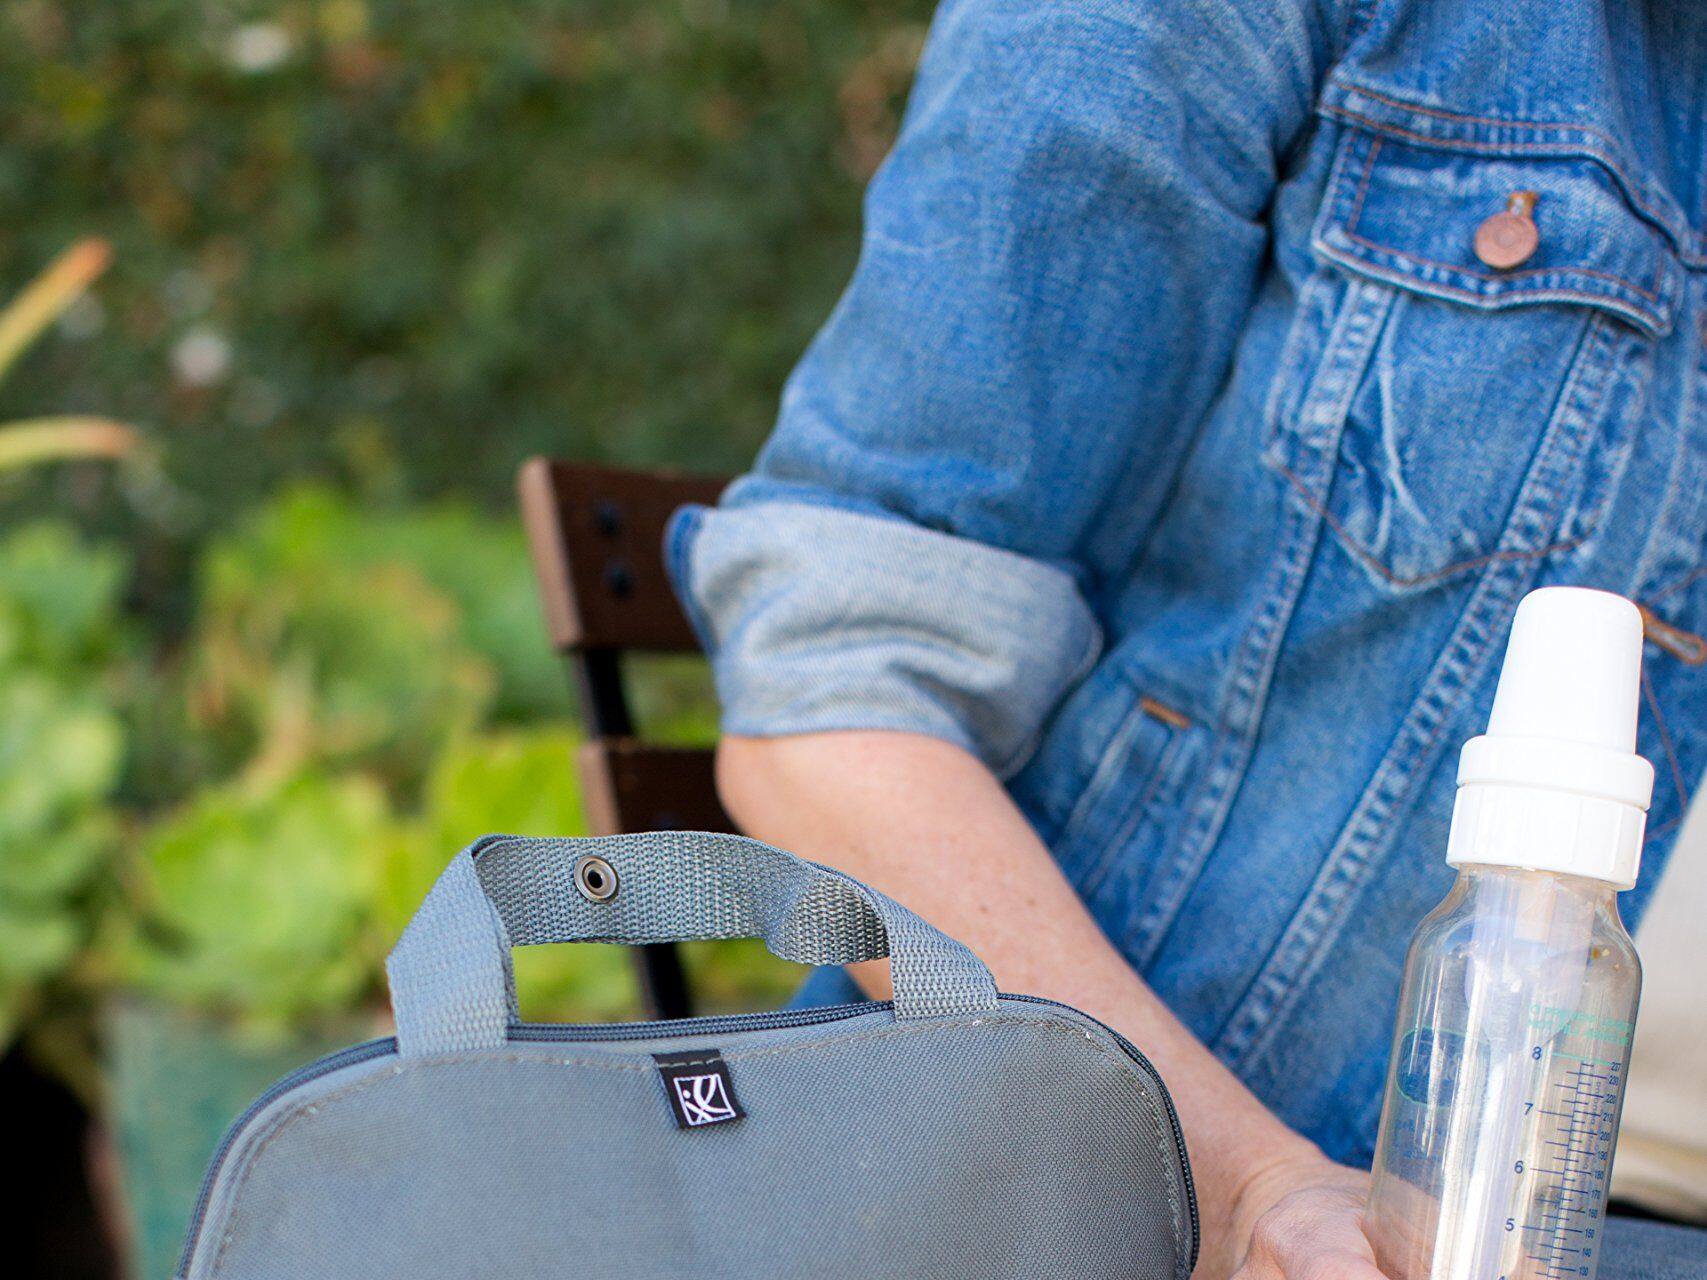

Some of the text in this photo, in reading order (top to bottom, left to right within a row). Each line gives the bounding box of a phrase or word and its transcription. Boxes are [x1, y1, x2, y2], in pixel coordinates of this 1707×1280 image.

[1531, 1046, 1542, 1060] 8
[1605, 1094, 1616, 1104] 220
[1524, 1102, 1534, 1116] 7
[1514, 1160, 1524, 1174] 6
[1504, 1218, 1515, 1232] 5
